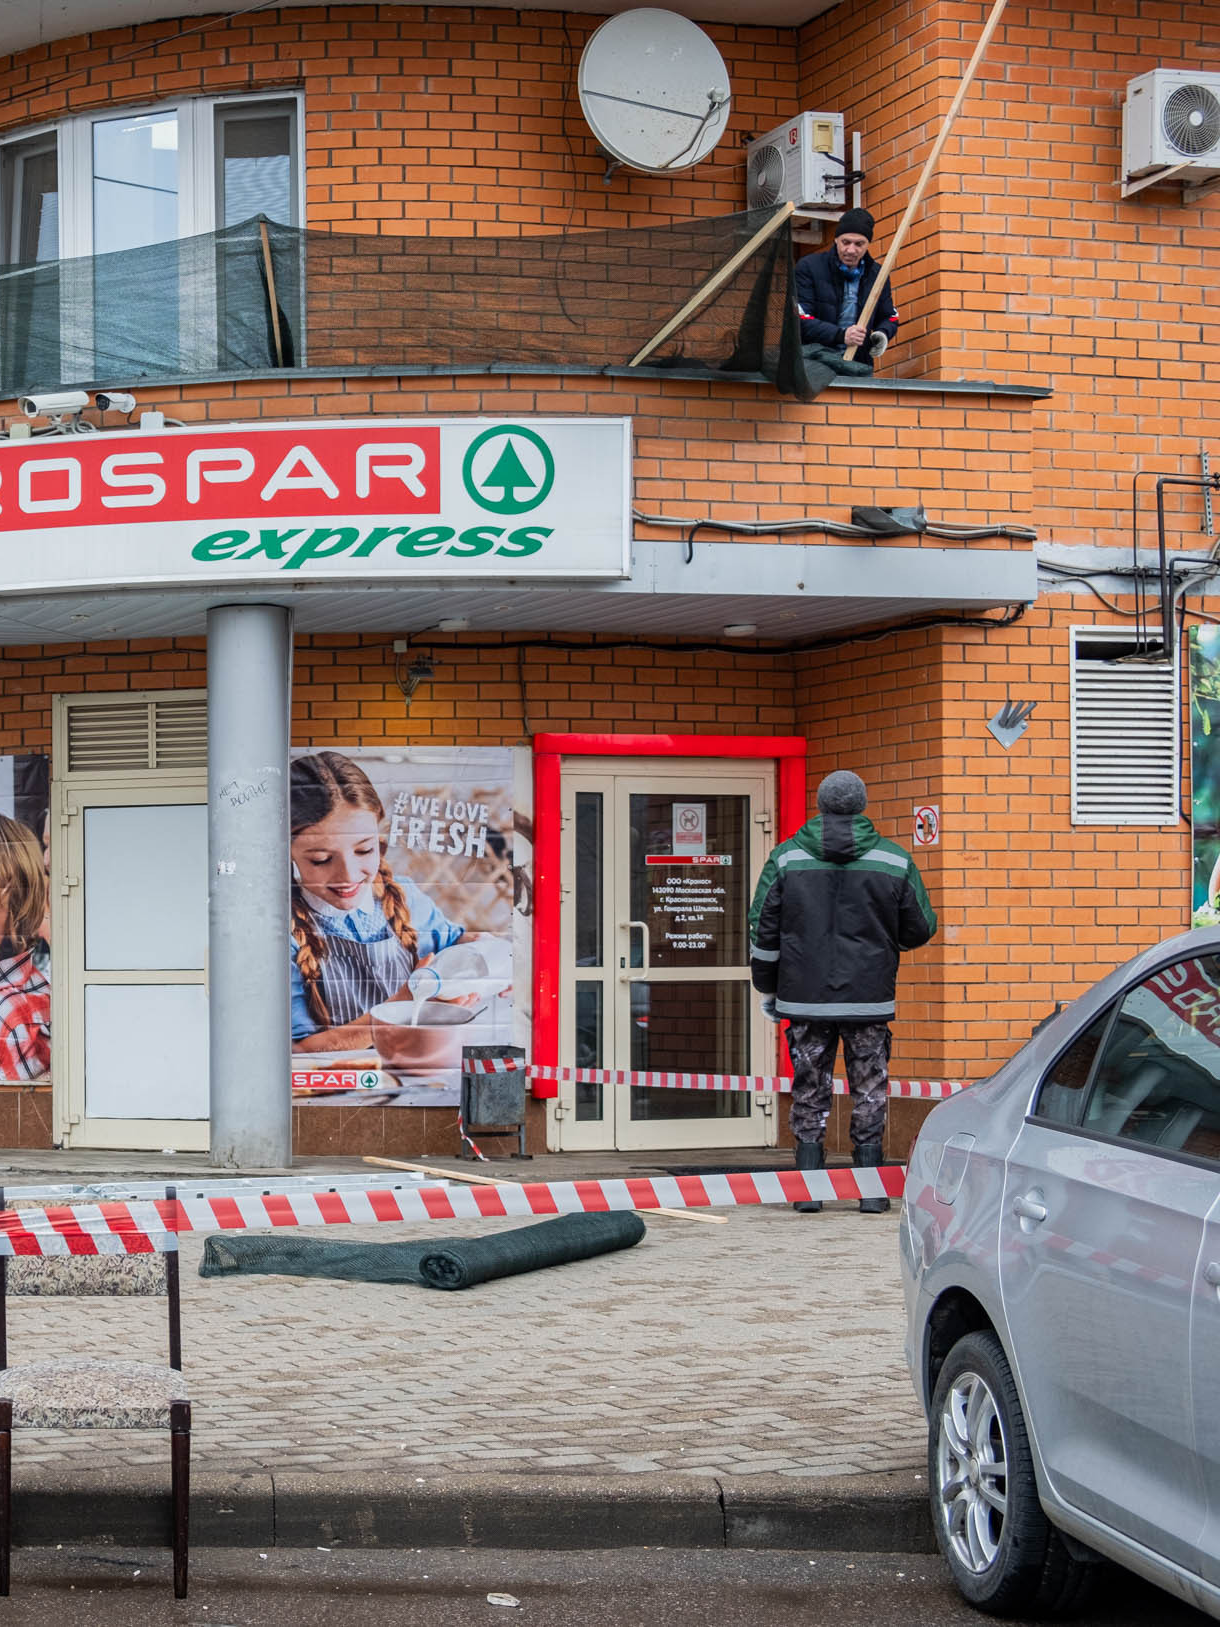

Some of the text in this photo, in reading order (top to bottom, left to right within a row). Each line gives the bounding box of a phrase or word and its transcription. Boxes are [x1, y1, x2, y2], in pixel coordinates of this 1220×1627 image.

[190, 525, 556, 570] express
[444, 799, 490, 824] LOVE
[387, 814, 488, 859] FRESH
[691, 856, 720, 864] SPAR
[293, 1074, 356, 1085] SPAR
